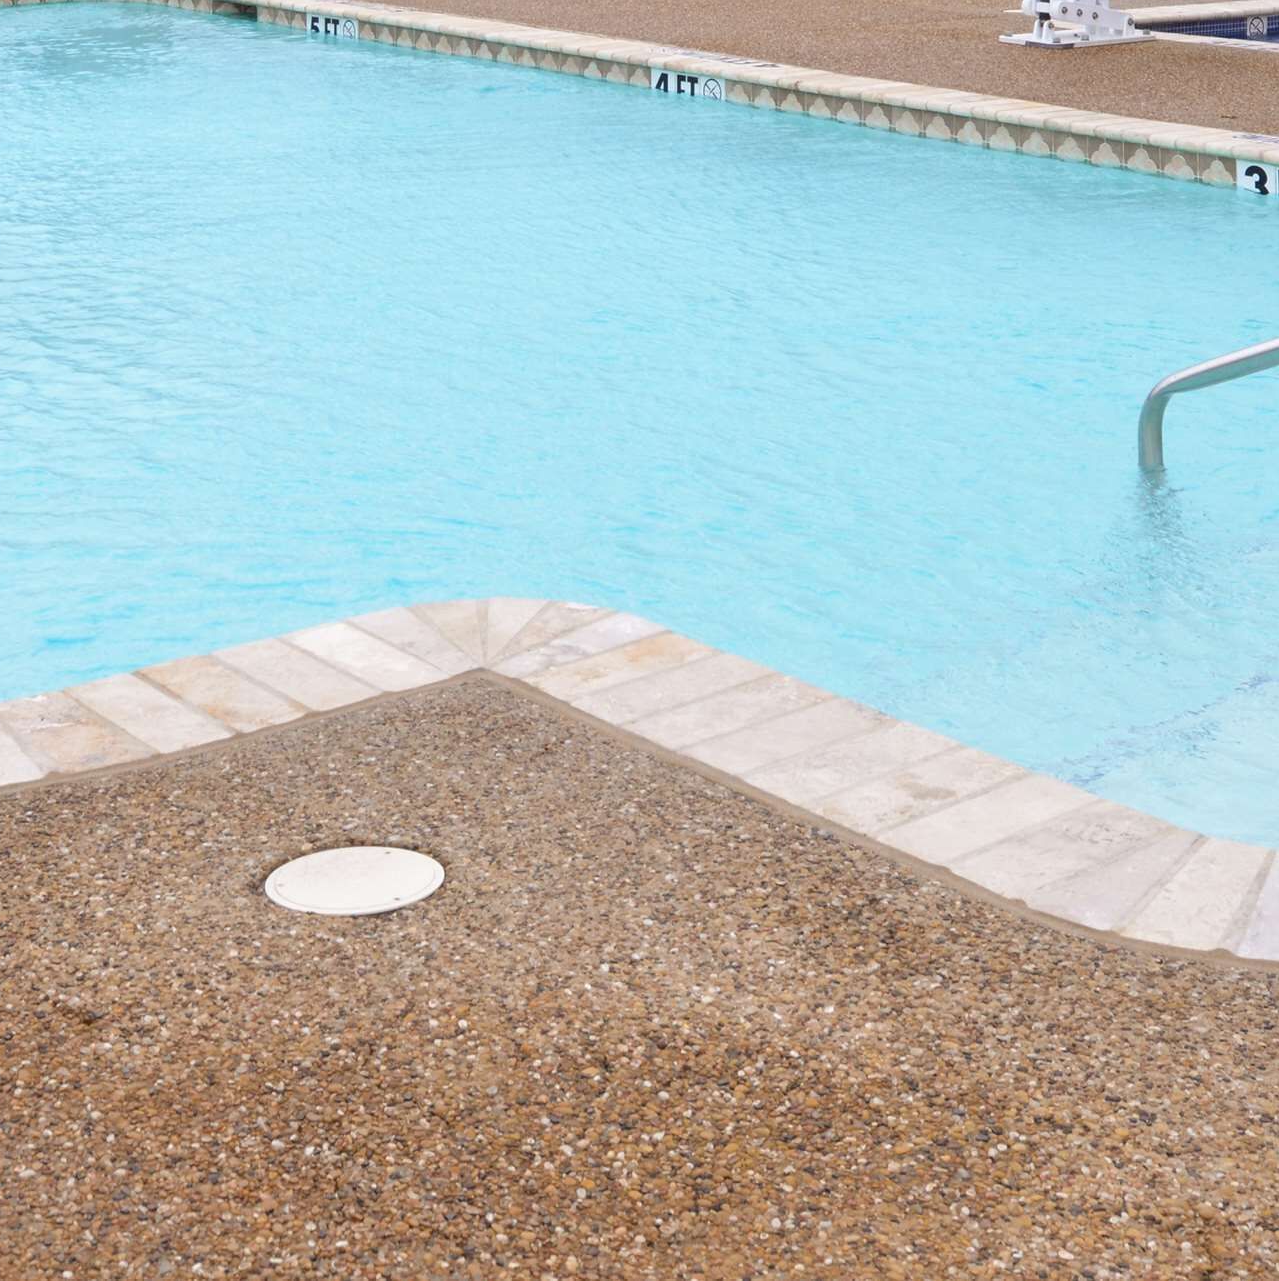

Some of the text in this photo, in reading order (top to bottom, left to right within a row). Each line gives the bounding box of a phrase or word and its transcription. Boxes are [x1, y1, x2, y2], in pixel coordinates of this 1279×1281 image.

[311, 16, 339, 36] 5 FT
[655, 72, 699, 97] 4 FT
[1245, 165, 1269, 195] 3
